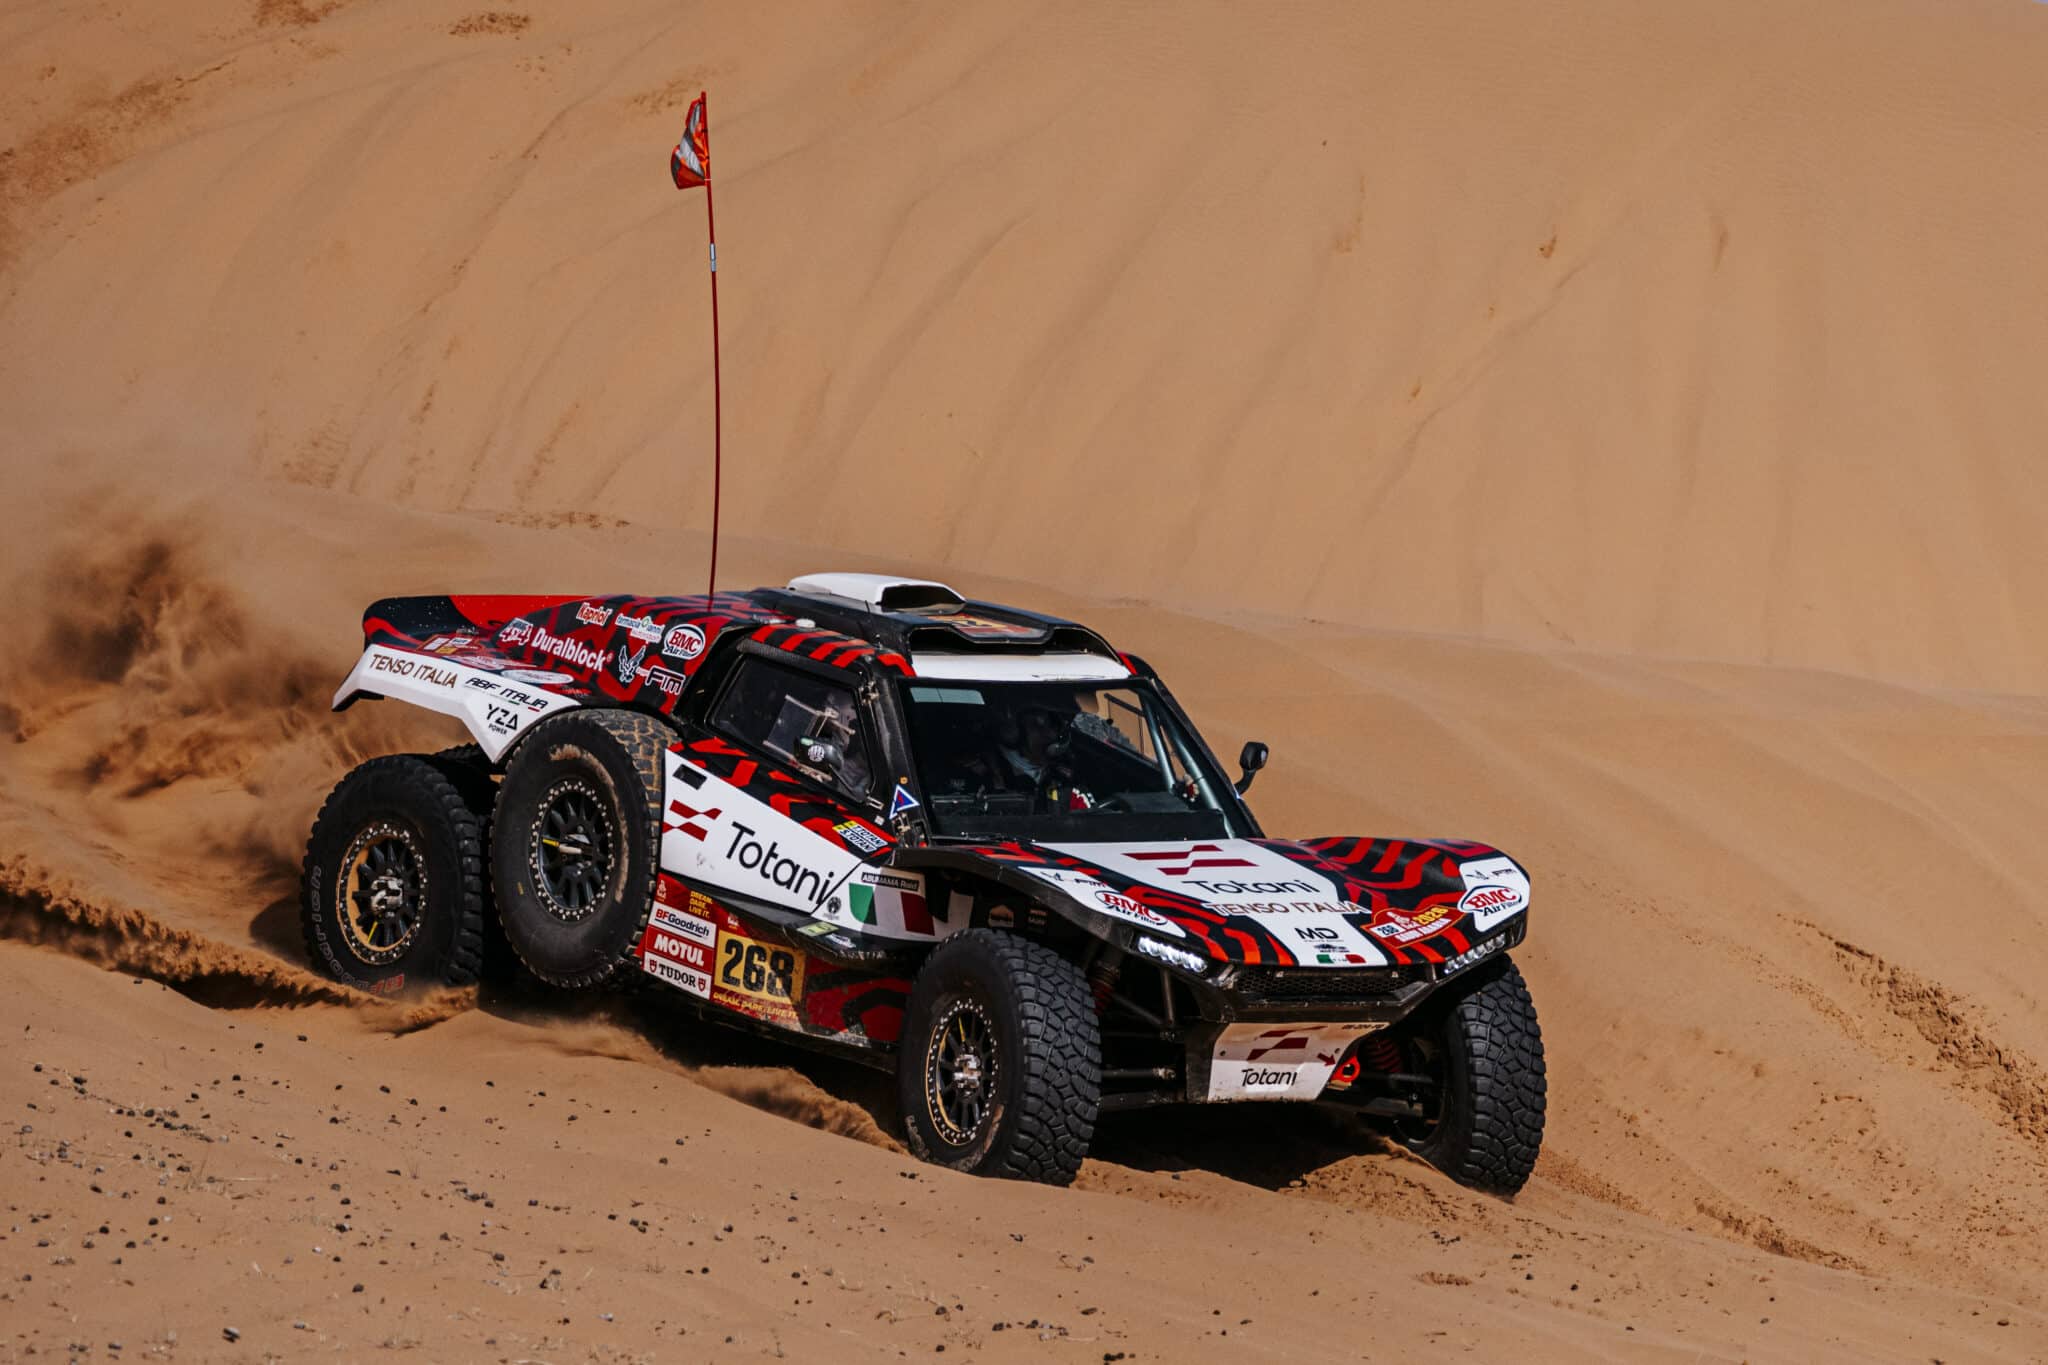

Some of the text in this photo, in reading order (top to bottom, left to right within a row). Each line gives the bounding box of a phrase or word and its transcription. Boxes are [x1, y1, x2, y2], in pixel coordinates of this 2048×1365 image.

[577, 603, 612, 625] Kapriol
[532, 627, 608, 672] Duralblock
[669, 631, 701, 653] BMC
[369, 654, 458, 688] TENSO ITALIA
[465, 677, 501, 690] ABF
[500, 688, 548, 709] ITALIA
[488, 723, 508, 735] POWER
[725, 820, 835, 905] Totani
[1181, 879, 1320, 894] Totani
[1102, 892, 1161, 921] BMC
[1206, 902, 1364, 915] TENSO ITALIA
[1465, 887, 1517, 909] BMC
[688, 905, 702, 915] LIVE
[1483, 903, 1503, 917] Air
[655, 908, 710, 937] BFGoodrich
[1294, 927, 1339, 939] MD
[654, 934, 704, 967] MOTUL
[659, 964, 696, 987] TUDOR
[722, 938, 795, 998] 268
[1241, 1068, 1298, 1087] Totani
